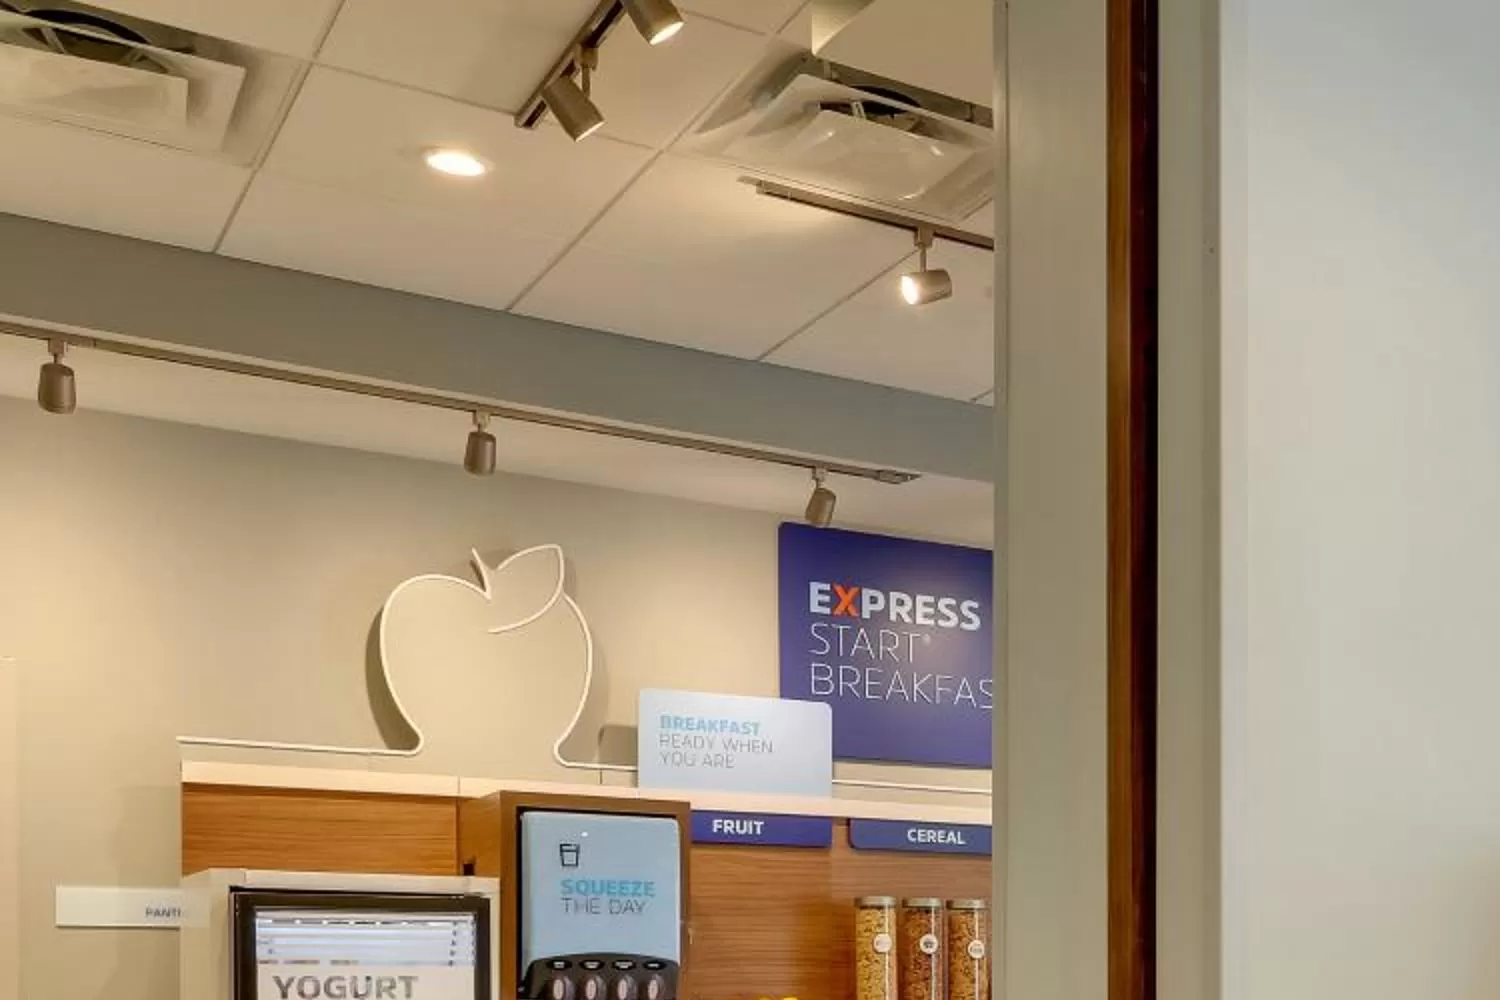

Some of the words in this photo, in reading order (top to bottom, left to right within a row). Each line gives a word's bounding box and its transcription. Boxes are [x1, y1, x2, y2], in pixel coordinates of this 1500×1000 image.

[809, 580, 981, 632] EXPRESS
[811, 662, 993, 709] BREAKFAS
[660, 714, 761, 736] BREAKFAST
[660, 733, 715, 751] READY
[721, 737, 774, 754] WHEN
[659, 751, 696, 768] YOU
[702, 753, 734, 769] ARE
[713, 818, 765, 837] FRUIT
[906, 827, 967, 846] CEREAL
[560, 879, 656, 897] SQUEEZE
[145, 907, 182, 918] PANT
[561, 897, 601, 915] THE
[608, 898, 647, 916] DAY
[272, 975, 419, 1000] YOGURT
